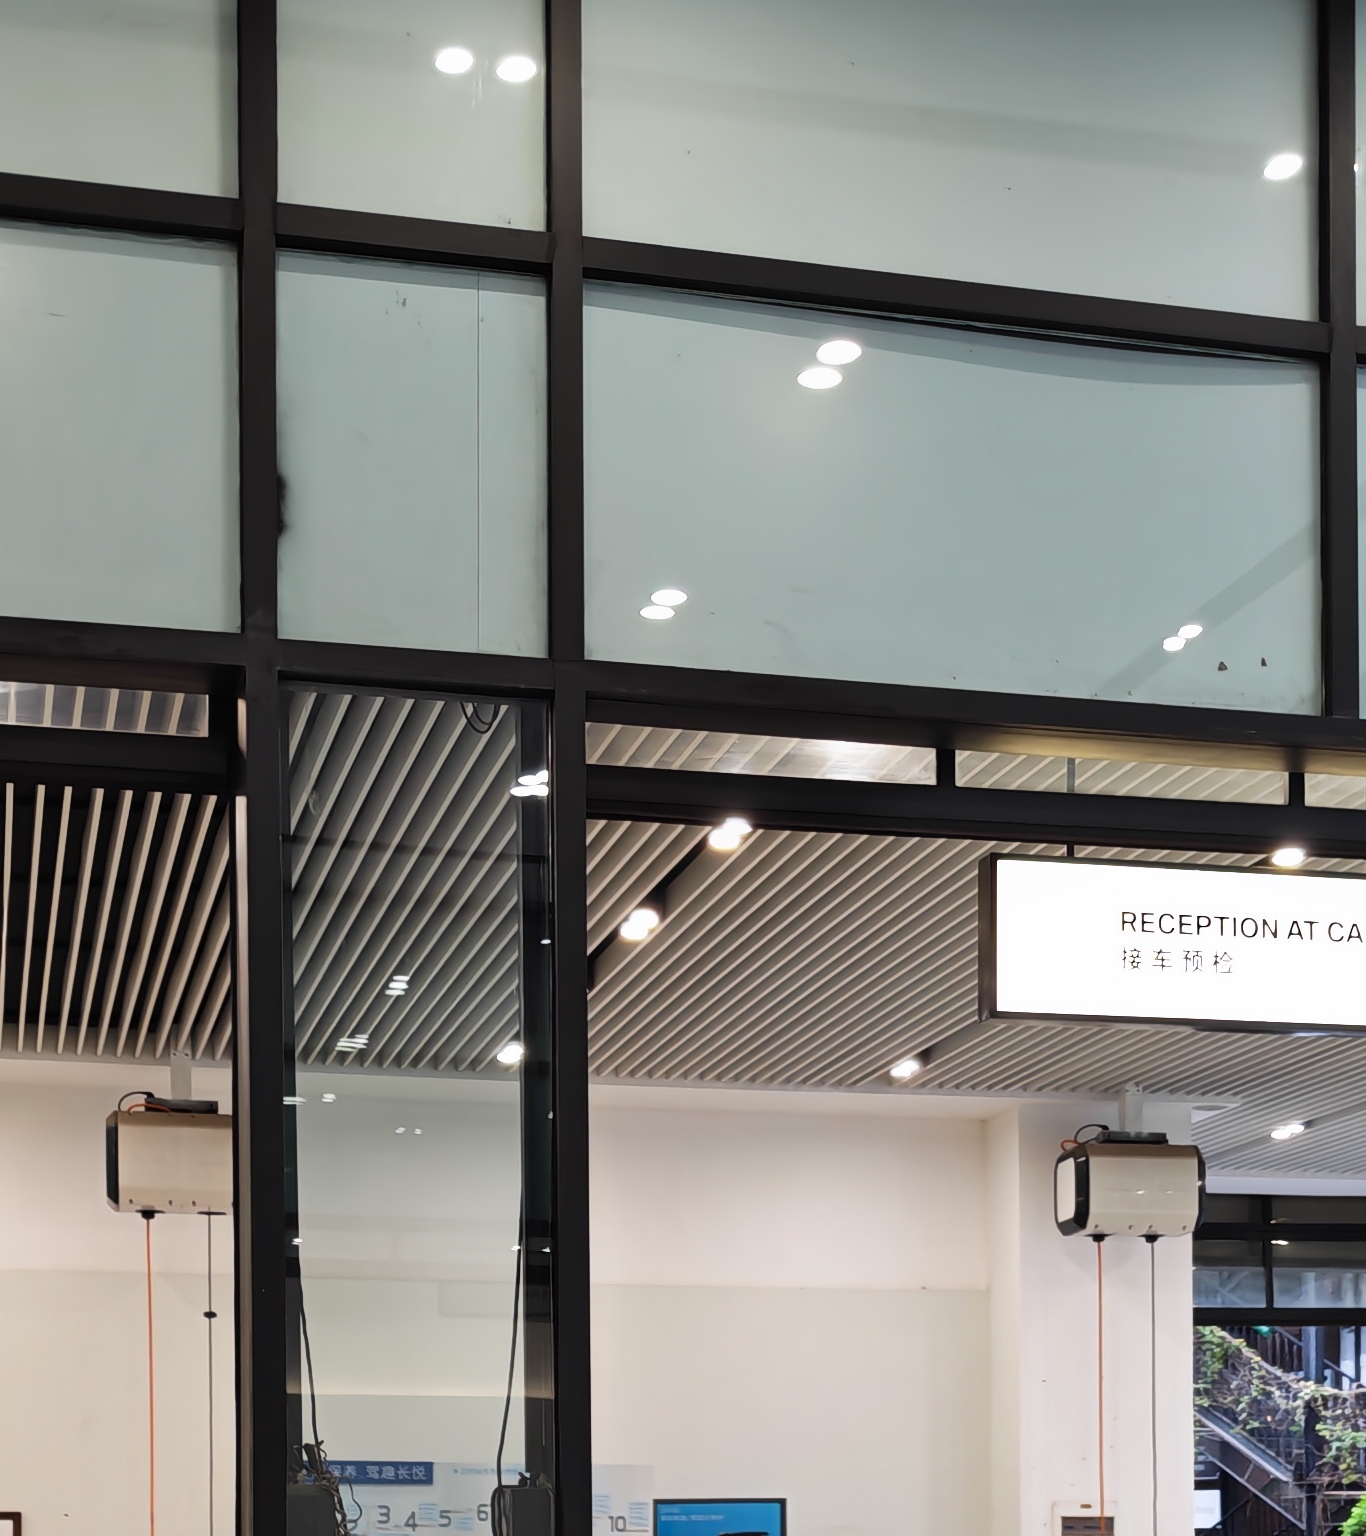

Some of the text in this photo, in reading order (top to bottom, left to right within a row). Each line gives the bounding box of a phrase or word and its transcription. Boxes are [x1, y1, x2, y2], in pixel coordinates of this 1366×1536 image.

[1121, 911, 1278, 939] RECEPTION
[1287, 920, 1319, 941] AT
[1121, 947, 1234, 974] 接车预检
[377, 1504, 391, 1525] 3
[403, 1511, 419, 1532] 4
[438, 1509, 452, 1528] 5
[476, 1503, 490, 1522] 6
[608, 1515, 627, 1533] 10
